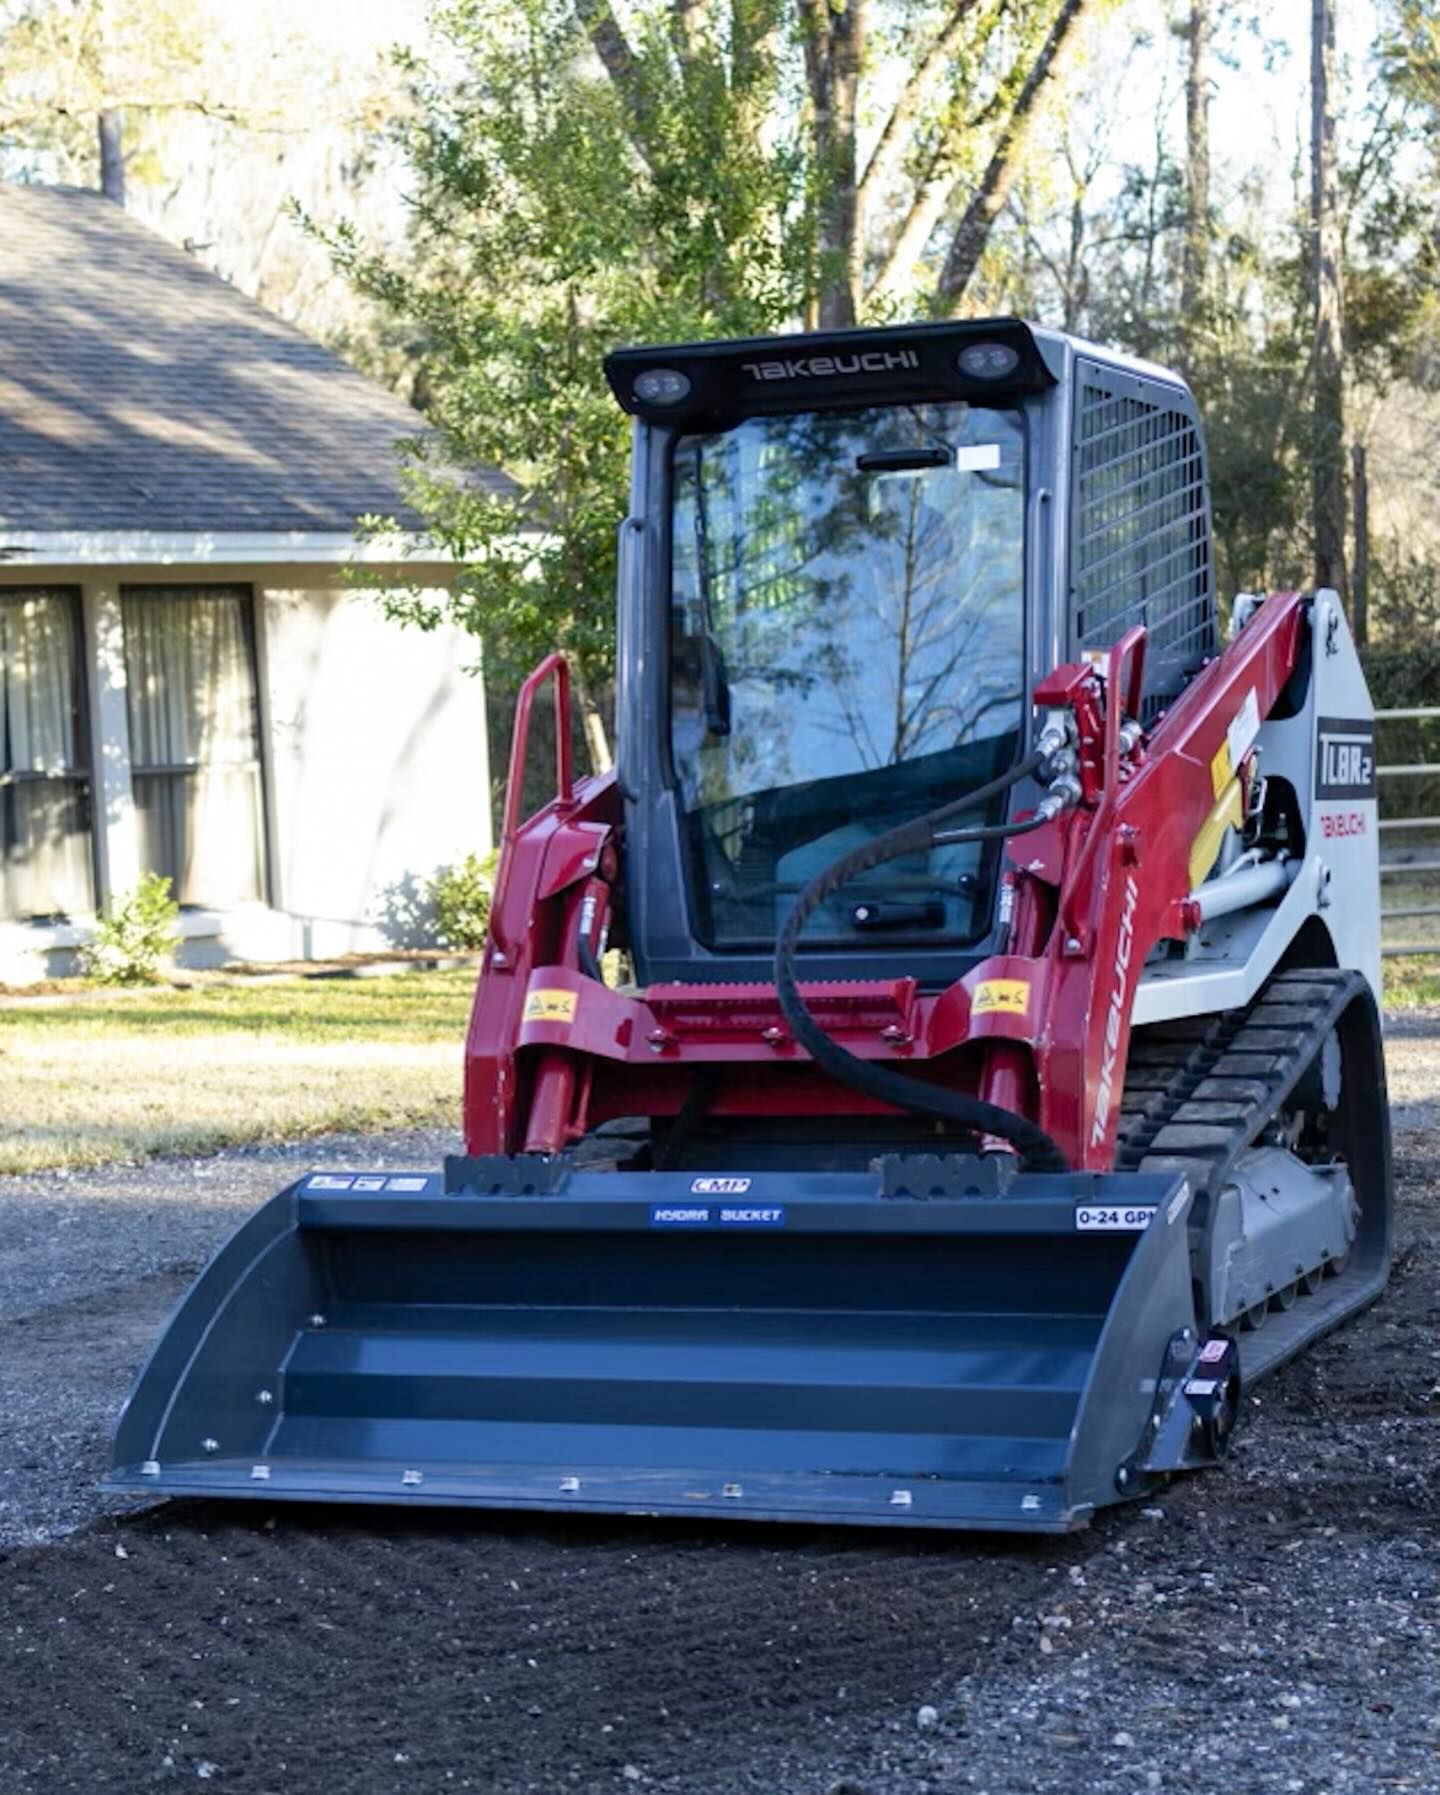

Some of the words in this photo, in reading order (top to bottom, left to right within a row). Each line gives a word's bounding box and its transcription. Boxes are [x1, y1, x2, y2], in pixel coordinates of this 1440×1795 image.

[742, 350, 919, 381] TAKEUCHI
[1091, 875, 1139, 1147] TAKEUCHI
[694, 1179, 750, 1192] CMP
[654, 1209, 708, 1222] HYDRA
[720, 1209, 781, 1222] BUCKET
[1079, 1210, 1119, 1224] 0-24
